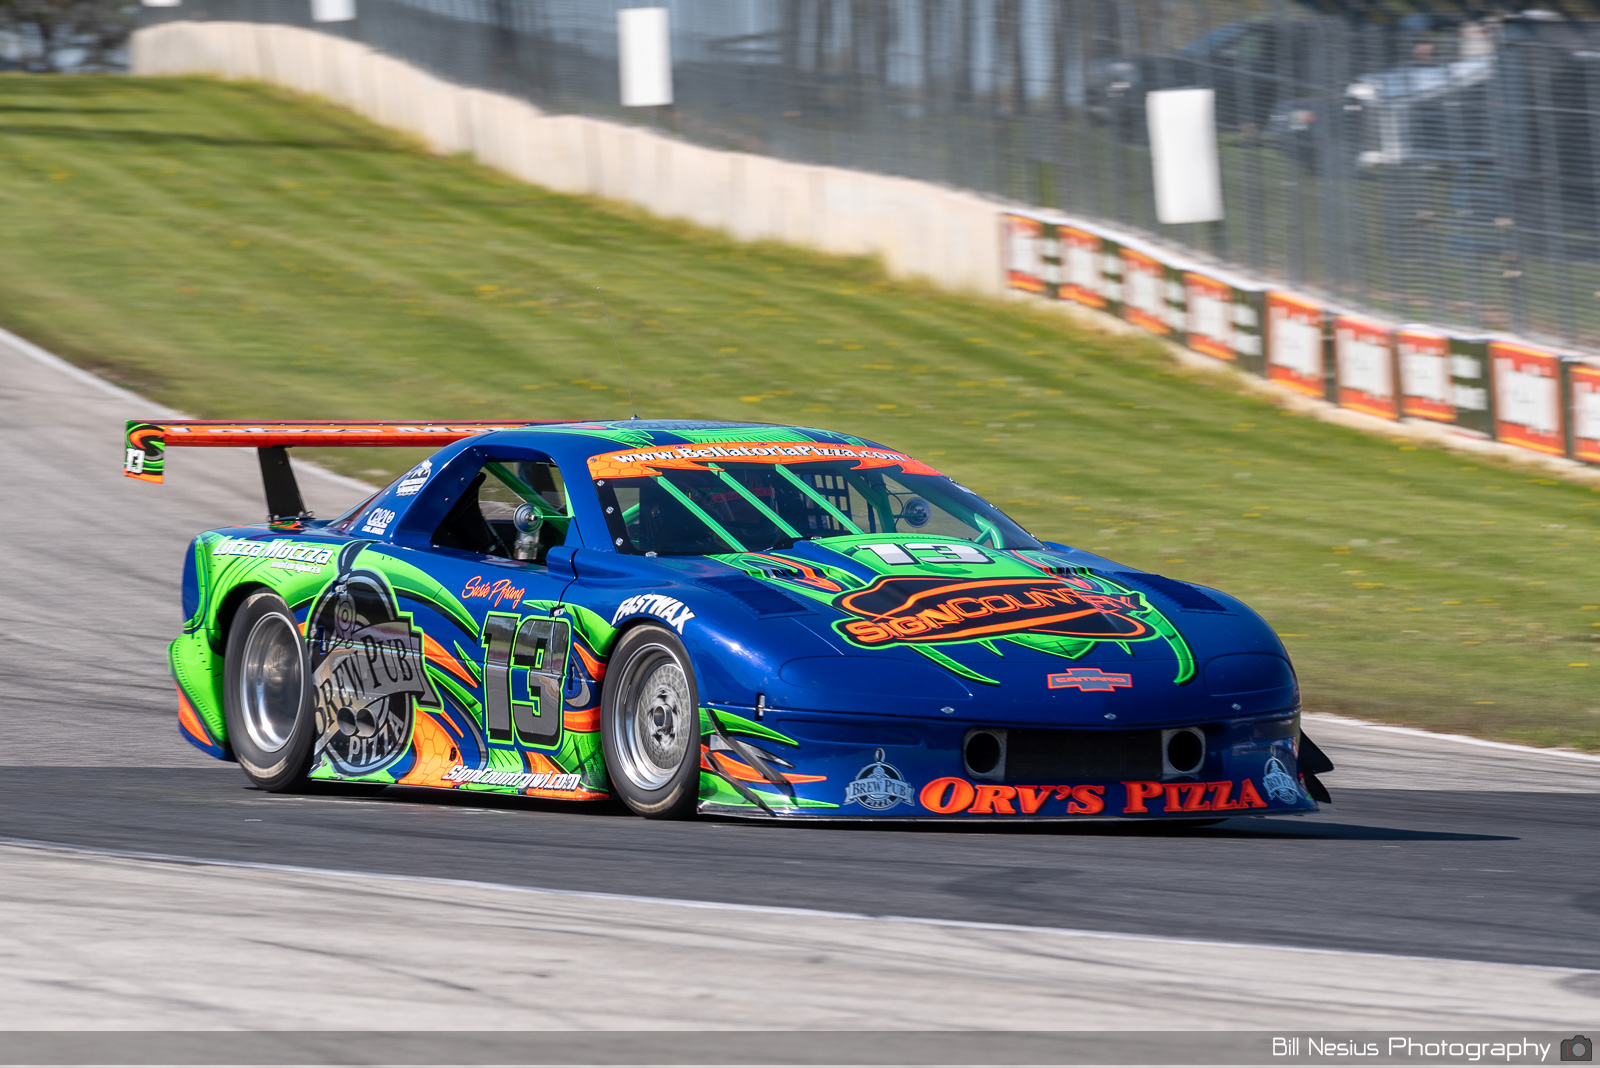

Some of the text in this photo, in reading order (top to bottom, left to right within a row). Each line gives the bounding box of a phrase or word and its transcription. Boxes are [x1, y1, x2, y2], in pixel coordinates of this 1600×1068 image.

[126, 448, 145, 474] 13
[611, 444, 908, 464] www.BellatoriaPizza.com
[212, 536, 334, 565] Lotzza Motzza
[858, 543, 995, 566] 13
[270, 560, 322, 574] motorsports
[611, 594, 696, 636] FASTWAX
[313, 634, 412, 736] BREW PUB
[482, 611, 573, 750] 13
[349, 711, 404, 765] PIZZA
[853, 779, 907, 797] BREW PUB
[1122, 778, 1269, 814] PIZZA
